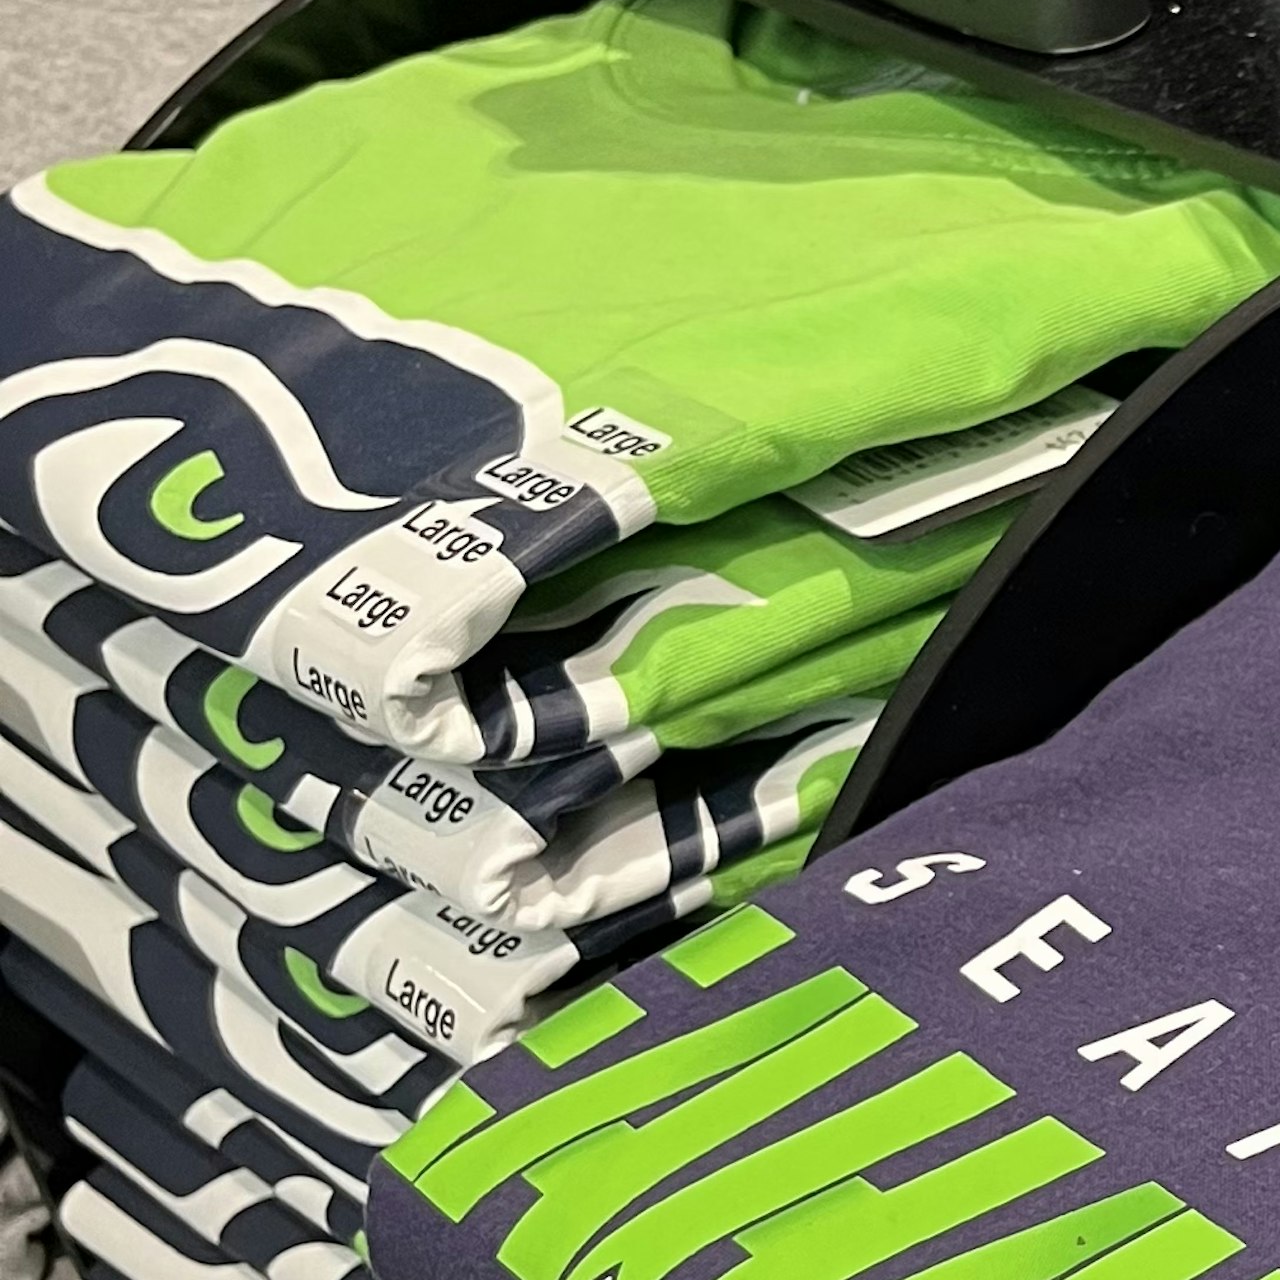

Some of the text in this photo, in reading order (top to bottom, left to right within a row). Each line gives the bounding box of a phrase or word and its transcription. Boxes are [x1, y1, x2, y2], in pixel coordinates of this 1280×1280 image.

[569, 407, 662, 457] Large
[484, 456, 575, 506] Large
[403, 502, 493, 562] Large
[326, 566, 411, 628] Large
[293, 647, 367, 721] Large
[388, 758, 475, 823] Large
[385, 959, 456, 1040] Large
